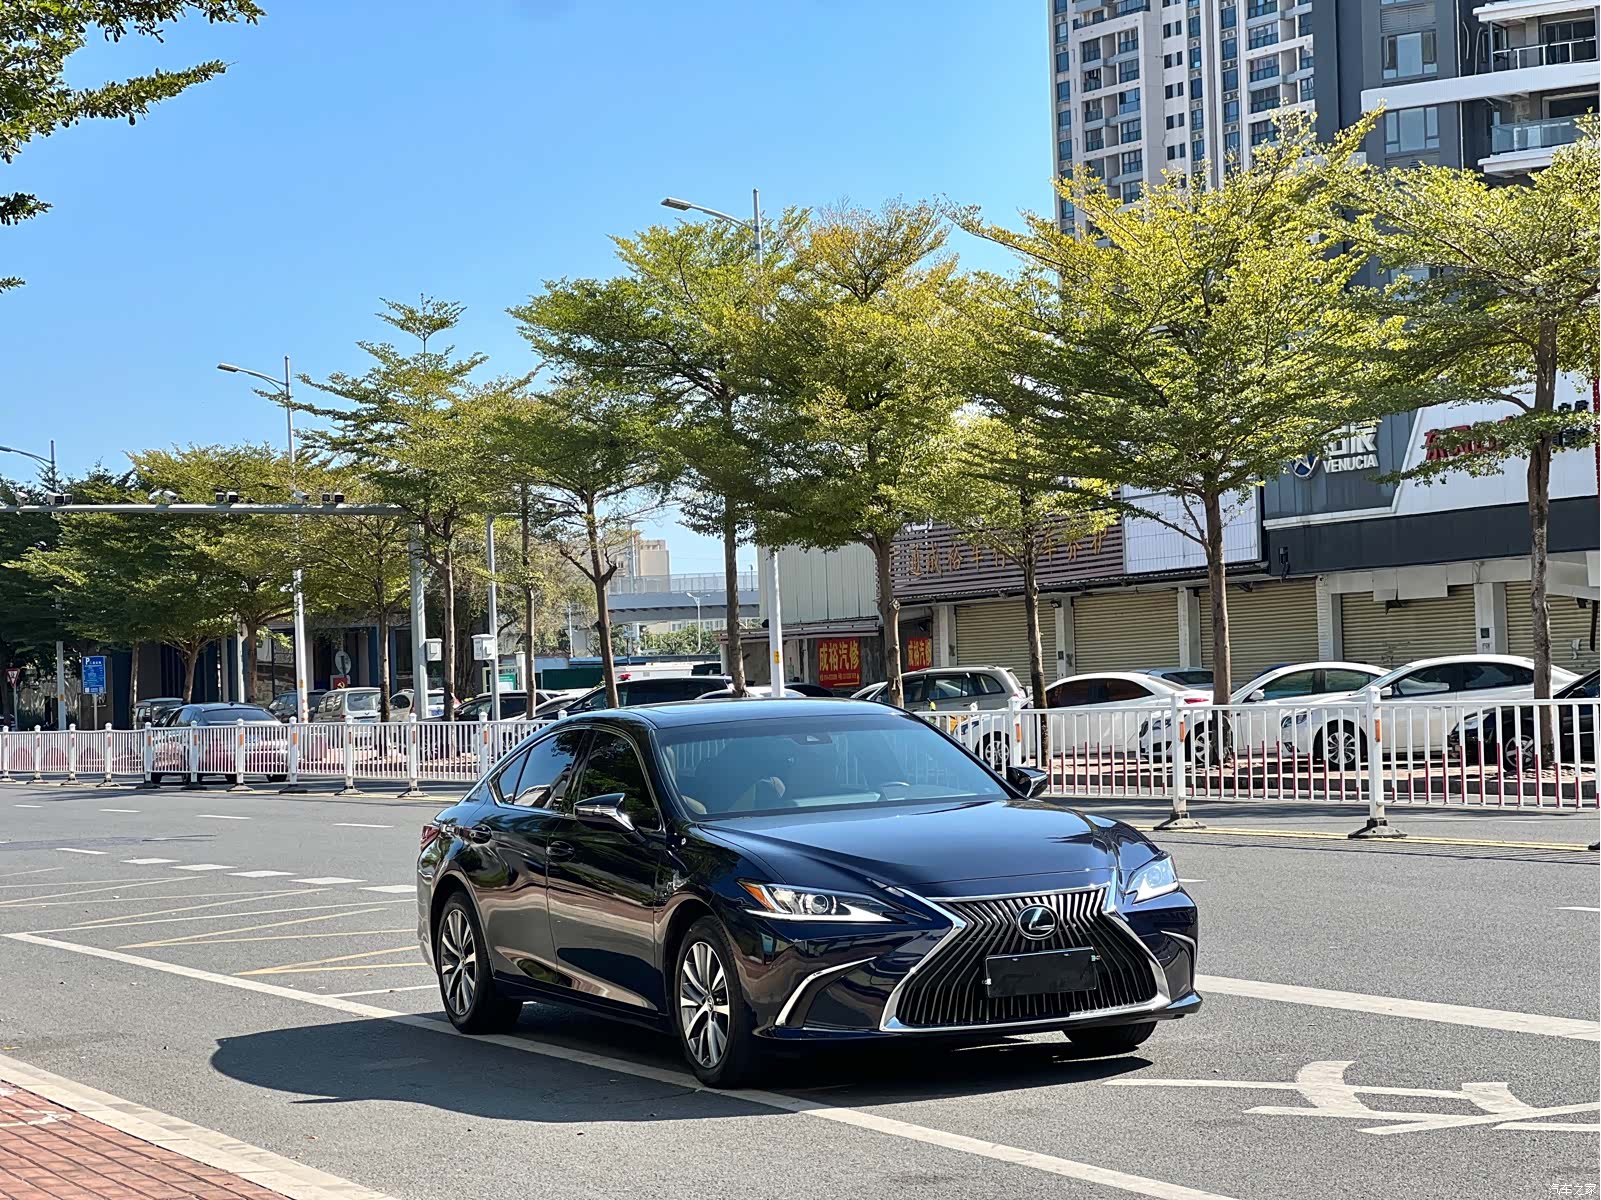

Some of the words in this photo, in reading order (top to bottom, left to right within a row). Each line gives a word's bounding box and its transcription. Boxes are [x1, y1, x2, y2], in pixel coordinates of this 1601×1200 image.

[1322, 454, 1379, 473] VENUCIA
[819, 641, 859, 672] 成裕汽修
[908, 640, 932, 667] 成裕汽修
